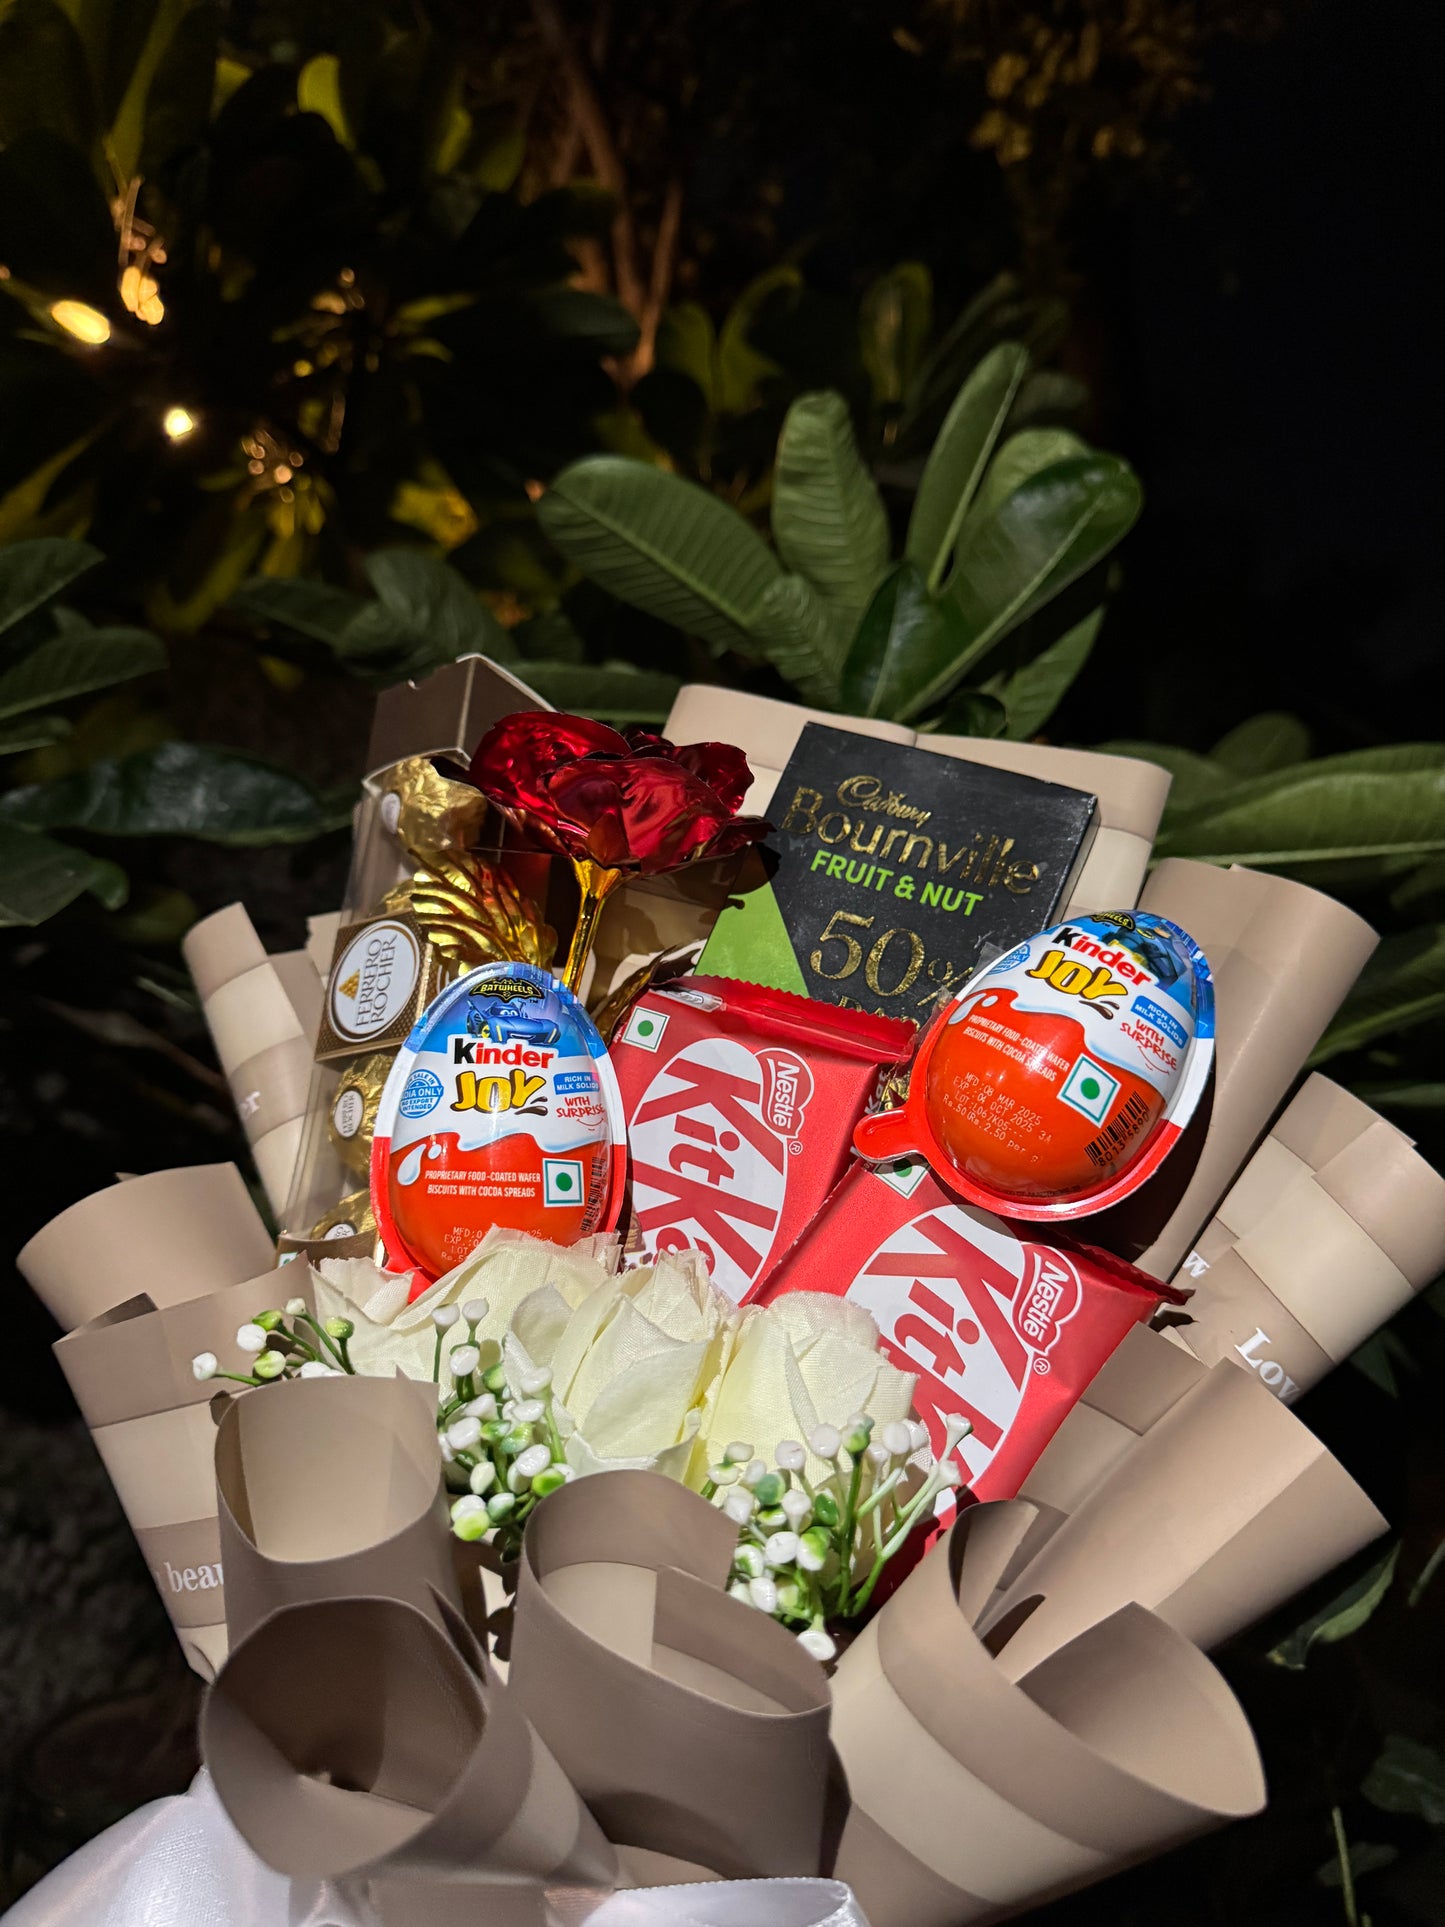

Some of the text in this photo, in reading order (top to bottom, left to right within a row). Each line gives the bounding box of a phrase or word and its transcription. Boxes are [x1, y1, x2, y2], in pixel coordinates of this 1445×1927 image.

[837, 775, 932, 828] Cadbury
[781, 786, 1039, 894] Bournville
[810, 849, 984, 917] FRUIT & NUT
[1051, 927, 1152, 986] Kinder
[355, 938, 383, 1027] FERRERO
[370, 934, 398, 1025] ROCHER
[480, 984, 534, 995] BATWHEELS
[1134, 1004, 1183, 1046] MILK SOLIDS
[1135, 1018, 1165, 1046] WITH
[1147, 1003, 1178, 1030] RICH IN
[453, 1037, 554, 1069] Kinder
[963, 1026, 989, 1042] BISCUITS
[986, 1036, 1005, 1051] WITH
[1001, 1044, 1027, 1064] COCOA
[968, 1014, 1005, 1034] PROPRIETARY
[1046, 1050, 1070, 1073] WAFER
[1120, 1022, 1177, 1071] SURPRISE
[418, 1086, 443, 1097] ONLY
[556, 1083, 575, 1091] MILK
[564, 1075, 582, 1083] RICH
[774, 1059, 801, 1129] Nestlé
[402, 1103, 433, 1112] INTENDED
[409, 1097, 433, 1105] EXPORT
[556, 1103, 606, 1118] SURPRISE
[564, 1095, 591, 1107] WITH
[990, 1101, 1008, 1117] OCT
[1010, 1113, 1035, 1133] 2025
[997, 1093, 1016, 1108] MAR
[1018, 1106, 1042, 1126] 2025
[425, 1170, 467, 1180] PROPRIETARY
[518, 1172, 541, 1182] WAFER
[427, 1184, 536, 1197] BISCUITS WITH COCOA SPREADS
[1024, 1259, 1069, 1342] Nestlé
